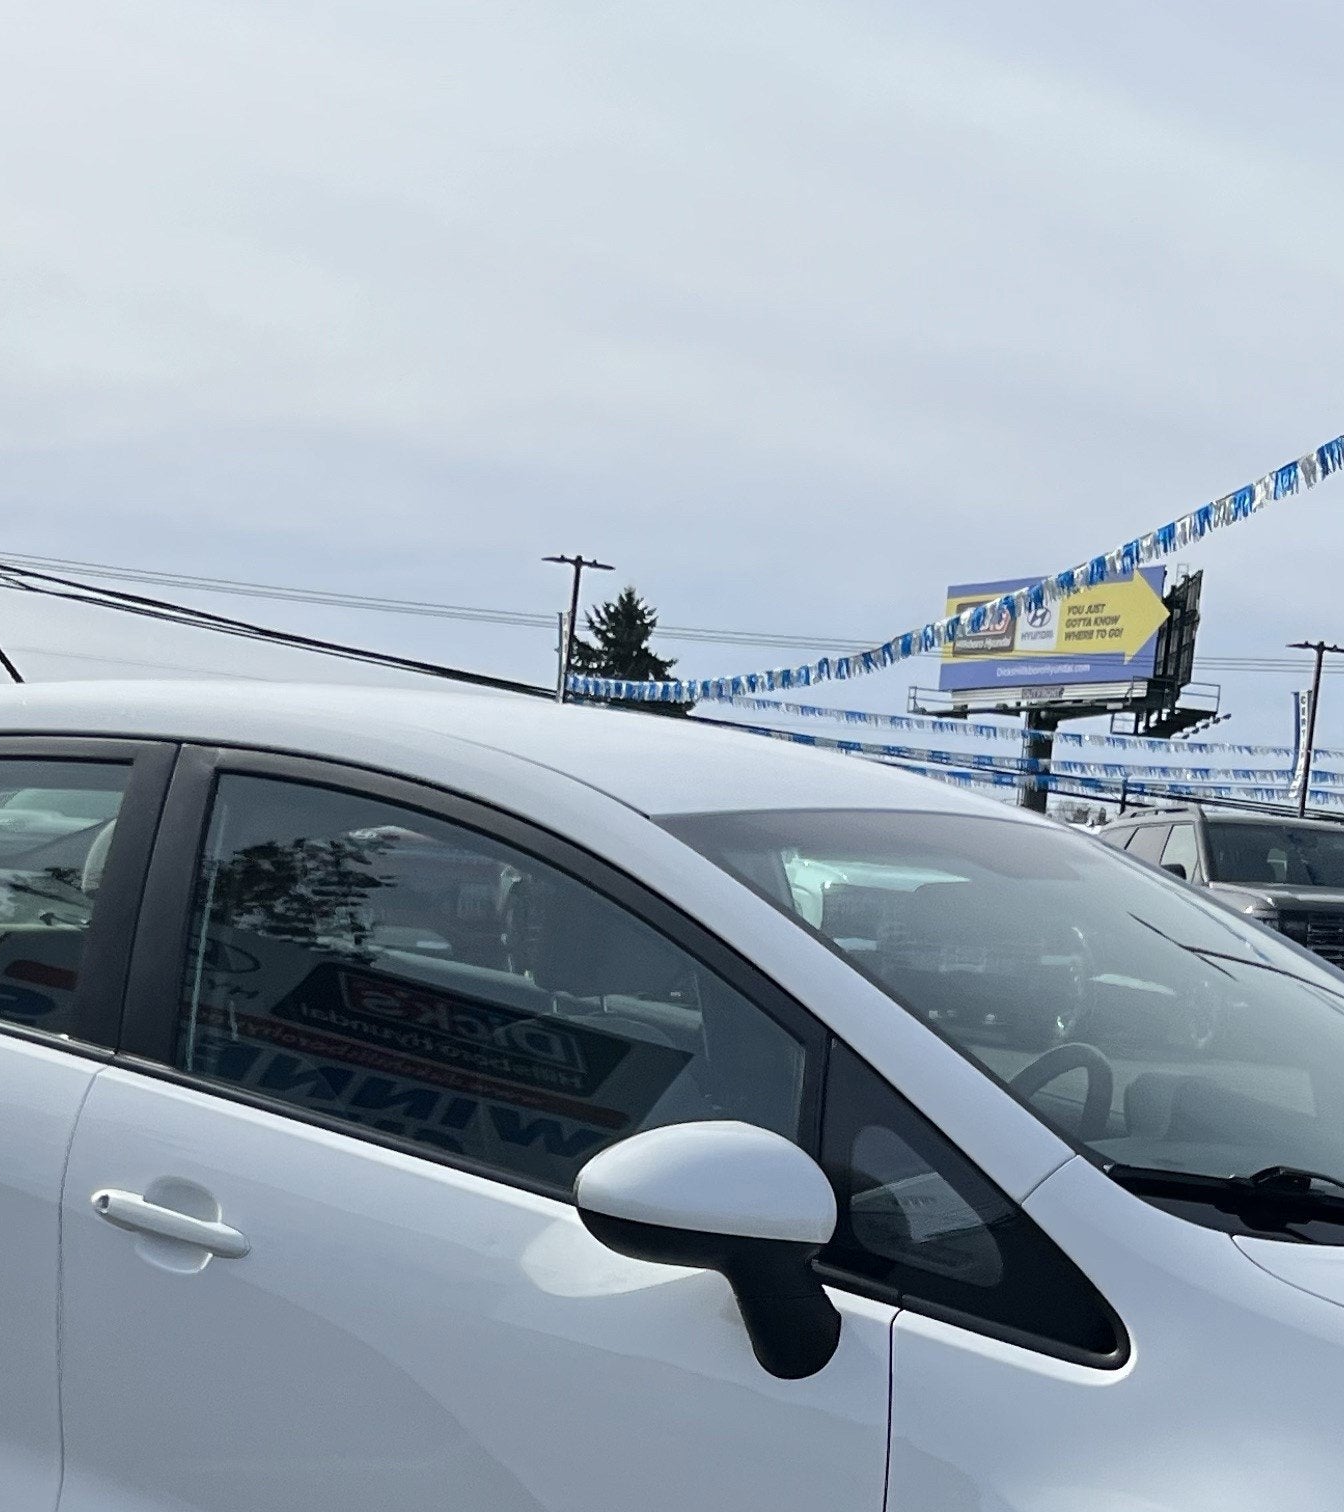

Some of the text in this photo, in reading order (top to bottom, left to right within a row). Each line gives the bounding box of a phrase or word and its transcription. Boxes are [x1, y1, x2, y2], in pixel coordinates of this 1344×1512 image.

[1067, 603, 1106, 615] YOU JUST
[1065, 614, 1120, 628] GOTTA KNOW
[1021, 630, 1054, 641] HYUNDAI
[1064, 629, 1094, 641] WHERE
[1096, 629, 1107, 639] TO
